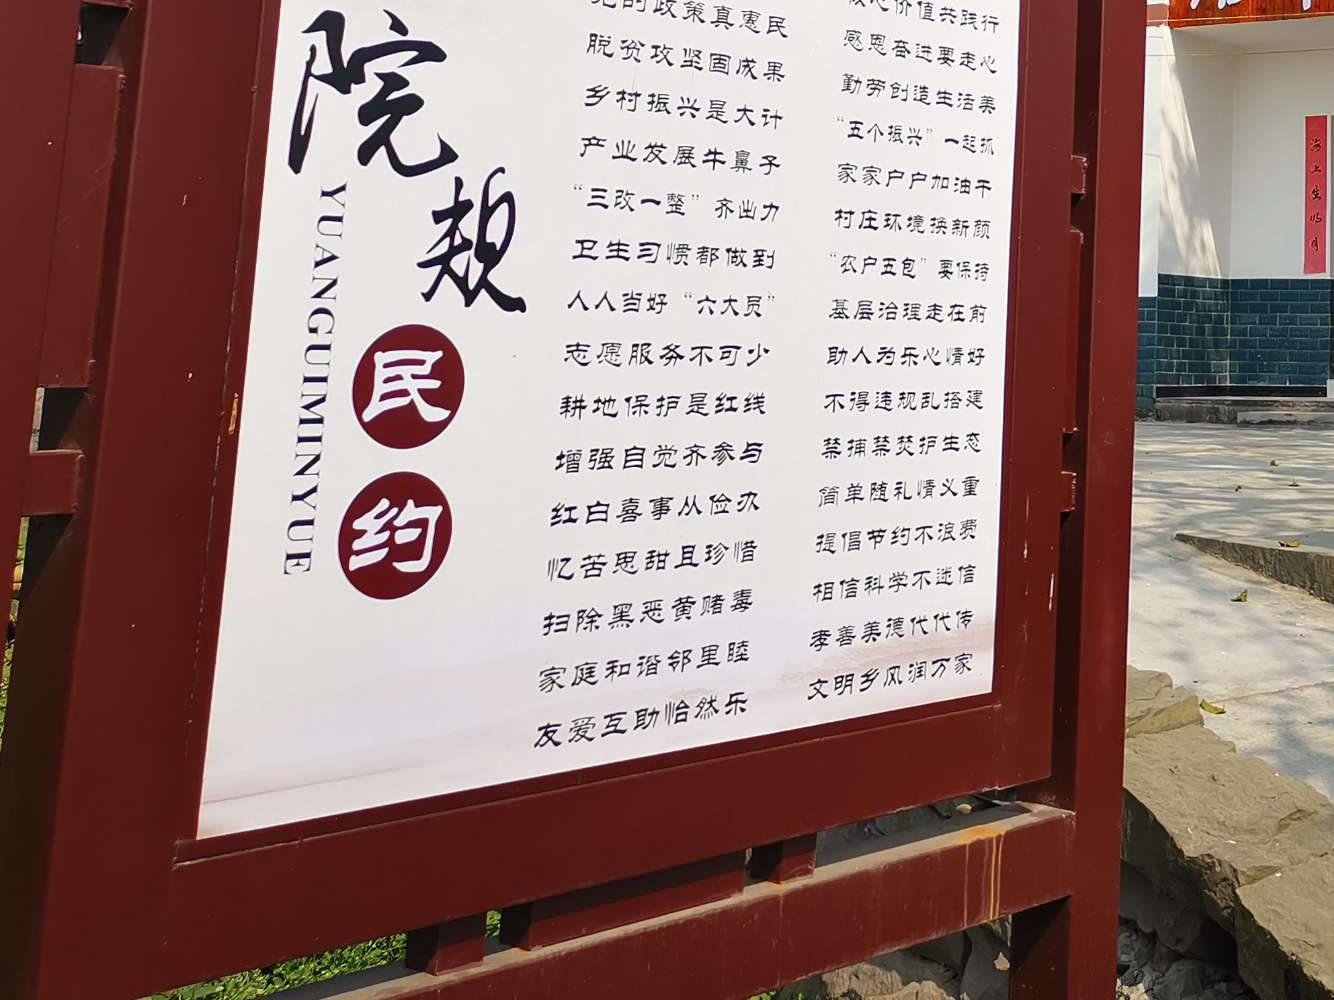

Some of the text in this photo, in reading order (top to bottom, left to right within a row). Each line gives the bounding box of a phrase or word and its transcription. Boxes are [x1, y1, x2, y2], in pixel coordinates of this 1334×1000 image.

[587, 33, 785, 82] 脱贫攻坚固成果
[844, 30, 997, 74] 感恩奋进要走心
[584, 84, 783, 129] 乡村振兴是大计
[841, 73, 995, 114] 勤劳创造生活美
[580, 136, 781, 175] 产业发展牛鼻子
[838, 163, 992, 198] 家家户户加油干
[835, 209, 990, 239] 村庄环境换新颜
[572, 239, 775, 269] 卫生习惯都做到
[829, 299, 987, 323] 基层治理走在前
[564, 342, 770, 367] 志愿服务不可少
[827, 346, 985, 367] 助人为乐心情好
[283, 181, 348, 576] YUANGUIMINYUE
[560, 392, 766, 420] 耕地保护是红线
[824, 390, 983, 413] 不得违规乱搭建
[555, 441, 763, 473] 增强自觉齐参与
[821, 432, 981, 459] 禁捕禁焚护生态
[550, 491, 760, 527] 红白喜事从俭办
[818, 476, 979, 507] 简单随礼情义重
[816, 519, 977, 554] 提倡节约不浪费
[548, 540, 757, 581] 忆苦思甜且珍惜
[813, 564, 976, 602] 相信科学不迷信
[543, 589, 753, 636] 扫除黑恶黄赌毒
[810, 610, 973, 652] 孝善美德代代传
[539, 640, 749, 693] 家庭和谐邻里睦
[808, 653, 972, 700] 文明乡风润万家
[534, 692, 748, 748] 友爱互助怡然乐
